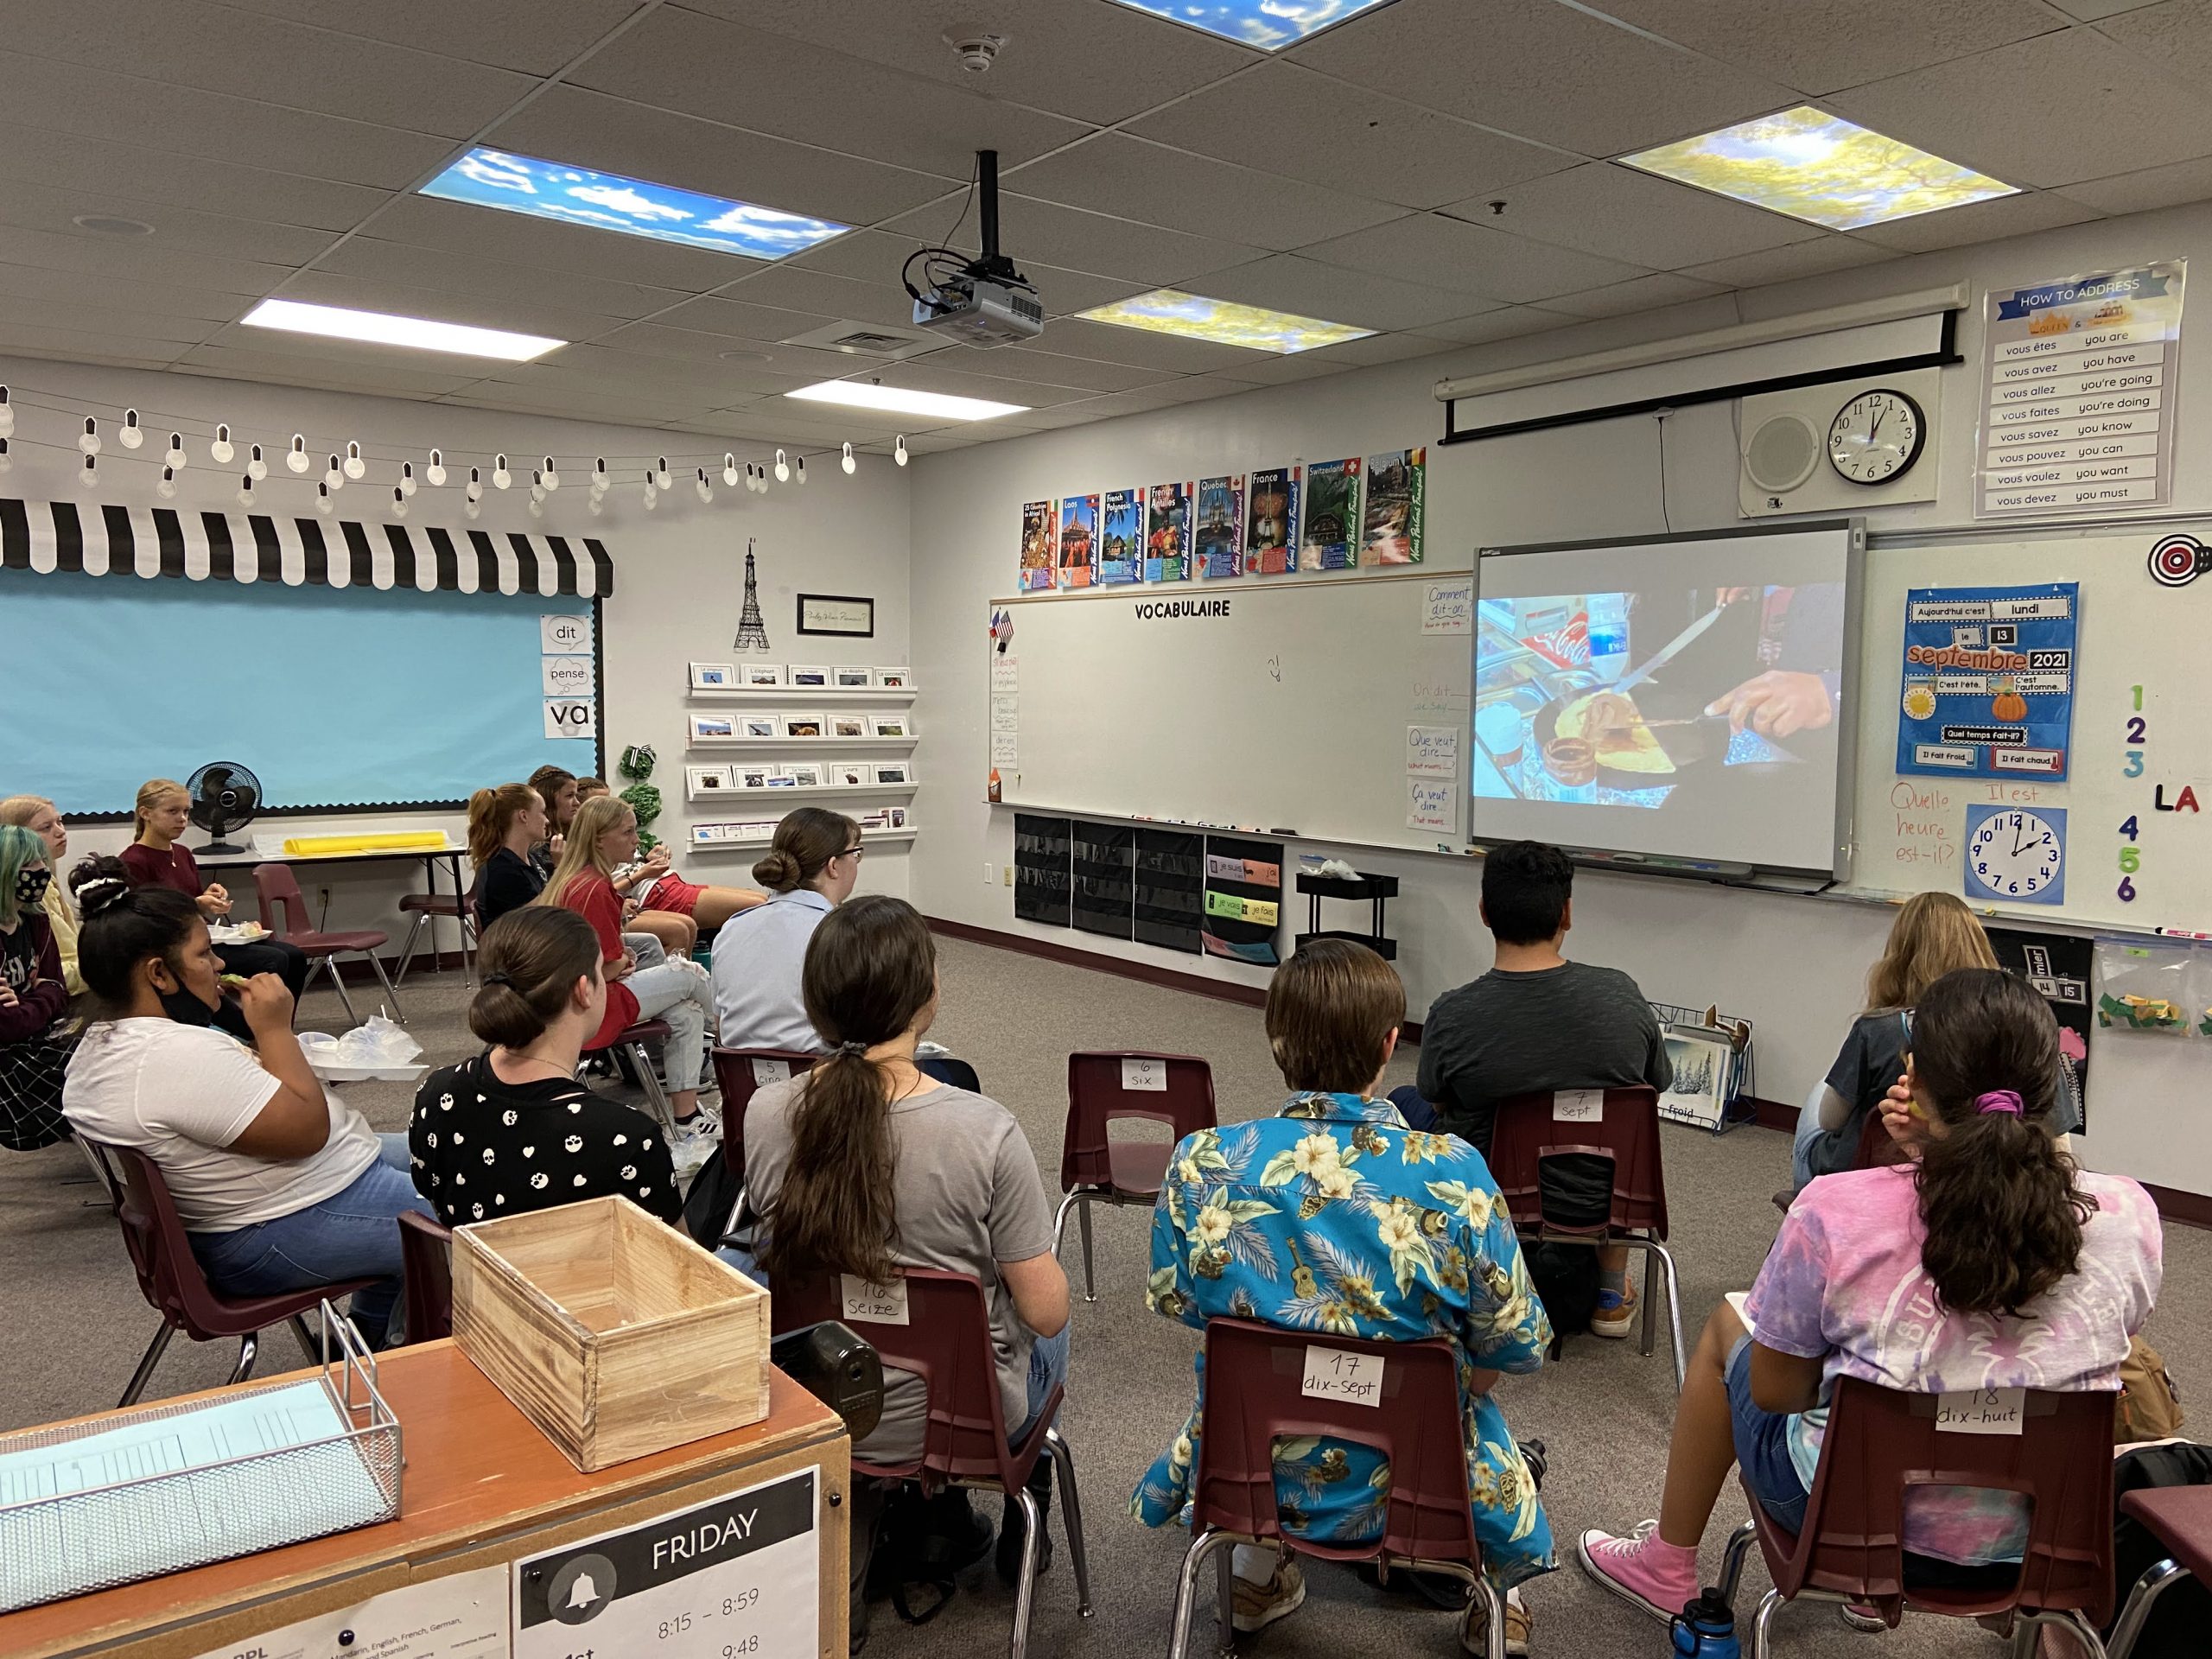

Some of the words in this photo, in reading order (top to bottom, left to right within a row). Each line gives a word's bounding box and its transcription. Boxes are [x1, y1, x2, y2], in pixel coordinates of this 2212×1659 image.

[2020, 292, 2053, 307] HOW
[2056, 289, 2073, 301] TO
[2077, 278, 2140, 299] ADDRESS
[2085, 335, 2106, 346] you
[2109, 332, 2129, 341] are
[2006, 346, 2031, 356] vous
[2033, 342, 2057, 352] êtes
[2083, 359, 2104, 369] you
[2107, 353, 2136, 365] have
[2005, 367, 2029, 378] vous
[2031, 364, 2058, 374] avez
[2081, 378, 2117, 391] you're
[2120, 374, 2153, 387] going
[2003, 389, 2028, 399] vous
[2031, 385, 2056, 396] allez
[1868, 395, 1882, 408] 12
[1888, 399, 1894, 410] 1
[2079, 401, 2114, 414] you're
[2117, 397, 2150, 409] doing
[1853, 404, 1863, 416] 11
[1899, 410, 1908, 423] 2
[2001, 410, 2026, 421] vous
[2030, 407, 2060, 417] faites
[1838, 416, 1850, 429] 10
[2078, 425, 2099, 436] you
[2101, 422, 2133, 431] know
[1904, 427, 1912, 439] 3
[2001, 433, 2025, 442] vous
[2028, 429, 2059, 439] savez
[1834, 435, 1842, 448] 9
[1898, 445, 1906, 457] 4
[1999, 454, 2024, 463] vous
[2026, 449, 2066, 462] pouvez
[2078, 447, 2099, 458] you
[2102, 444, 2123, 454] can
[1309, 464, 1344, 476] Switzerland
[1370, 457, 1400, 472] Belgium
[1851, 463, 1859, 475] 7
[1885, 460, 1892, 472] 5
[1867, 466, 1875, 478] 6
[2075, 469, 2097, 480] you
[2100, 465, 2129, 476] want
[1252, 474, 1278, 484] France
[1998, 474, 2023, 485] vous
[1106, 493, 1123, 503] French
[1151, 487, 1173, 498] French
[1997, 496, 2022, 505] vous
[2024, 493, 2056, 504] devez
[2075, 491, 2096, 501] you
[2100, 487, 2128, 499] must
[1064, 500, 1078, 509] Laos
[1106, 504, 1131, 513] Polynesia
[1151, 499, 1176, 508] Antilles
[1429, 586, 1471, 602] Comment
[1135, 600, 1230, 620] VOCABULAIRE
[1433, 604, 1464, 614] dit-on
[1918, 607, 1963, 617] Aujourd'hui
[2012, 604, 2039, 615] lundi
[556, 626, 576, 639] dit
[1998, 630, 2008, 640] 13
[1908, 646, 2027, 671] septembre
[2033, 654, 2067, 667] 2021
[551, 670, 584, 680] pense
[2130, 684, 2144, 711] 1
[550, 705, 589, 725] va
[1967, 731, 1990, 740] temps
[2126, 716, 2146, 744] 2
[1409, 728, 1431, 747] Que
[1434, 736, 1455, 747] veut
[2123, 751, 2145, 778] 3
[1412, 783, 1424, 803] Ça
[1428, 787, 1447, 801] veut
[1985, 784, 2004, 801] Il
[2012, 787, 2040, 803] est
[2154, 783, 2200, 813] LA
[1897, 813, 1949, 840] heure
[1994, 818, 2003, 830] 11
[2009, 814, 2022, 827] 12
[2031, 819, 2035, 831] 1
[2118, 815, 2139, 842] 4
[1980, 830, 1993, 842] 10
[2042, 832, 2051, 844] 2
[1896, 843, 1955, 869] est-il?
[1973, 844, 1982, 857] 9
[2048, 849, 2057, 862] 3
[2118, 846, 2140, 874] 5
[1978, 862, 1987, 874] 8
[2040, 867, 2050, 880] 4
[1993, 874, 2002, 887] 7
[2008, 881, 2018, 893] 6
[2027, 878, 2037, 891] 5
[2117, 874, 2136, 902] 6
[1227, 901, 1240, 910] vais
[1252, 906, 1259, 915] je
[1261, 906, 1274, 916] fais
[2039, 982, 2050, 992] 14
[2064, 986, 2075, 997] 15
[767, 1062, 775, 1073] 5
[1141, 1061, 1150, 1071] 6
[1574, 1091, 1586, 1104] 7
[1669, 1104, 1694, 1118] froid
[861, 1280, 886, 1298] 16
[1331, 1354, 1361, 1376] 17
[1304, 1375, 1376, 1398] dix-sept
[1972, 1389, 1999, 1406] 18
[1936, 1407, 2018, 1424] dix-huit
[652, 1509, 759, 1570] FRIDAY
[658, 1611, 691, 1640] 8:15
[721, 1587, 760, 1617] 8:59
[372, 1637, 400, 1650] English,
[401, 1628, 429, 1641] French,
[429, 1618, 462, 1632] German,
[380, 1643, 410, 1656] Spanish
[722, 1635, 759, 1659] 9:48
